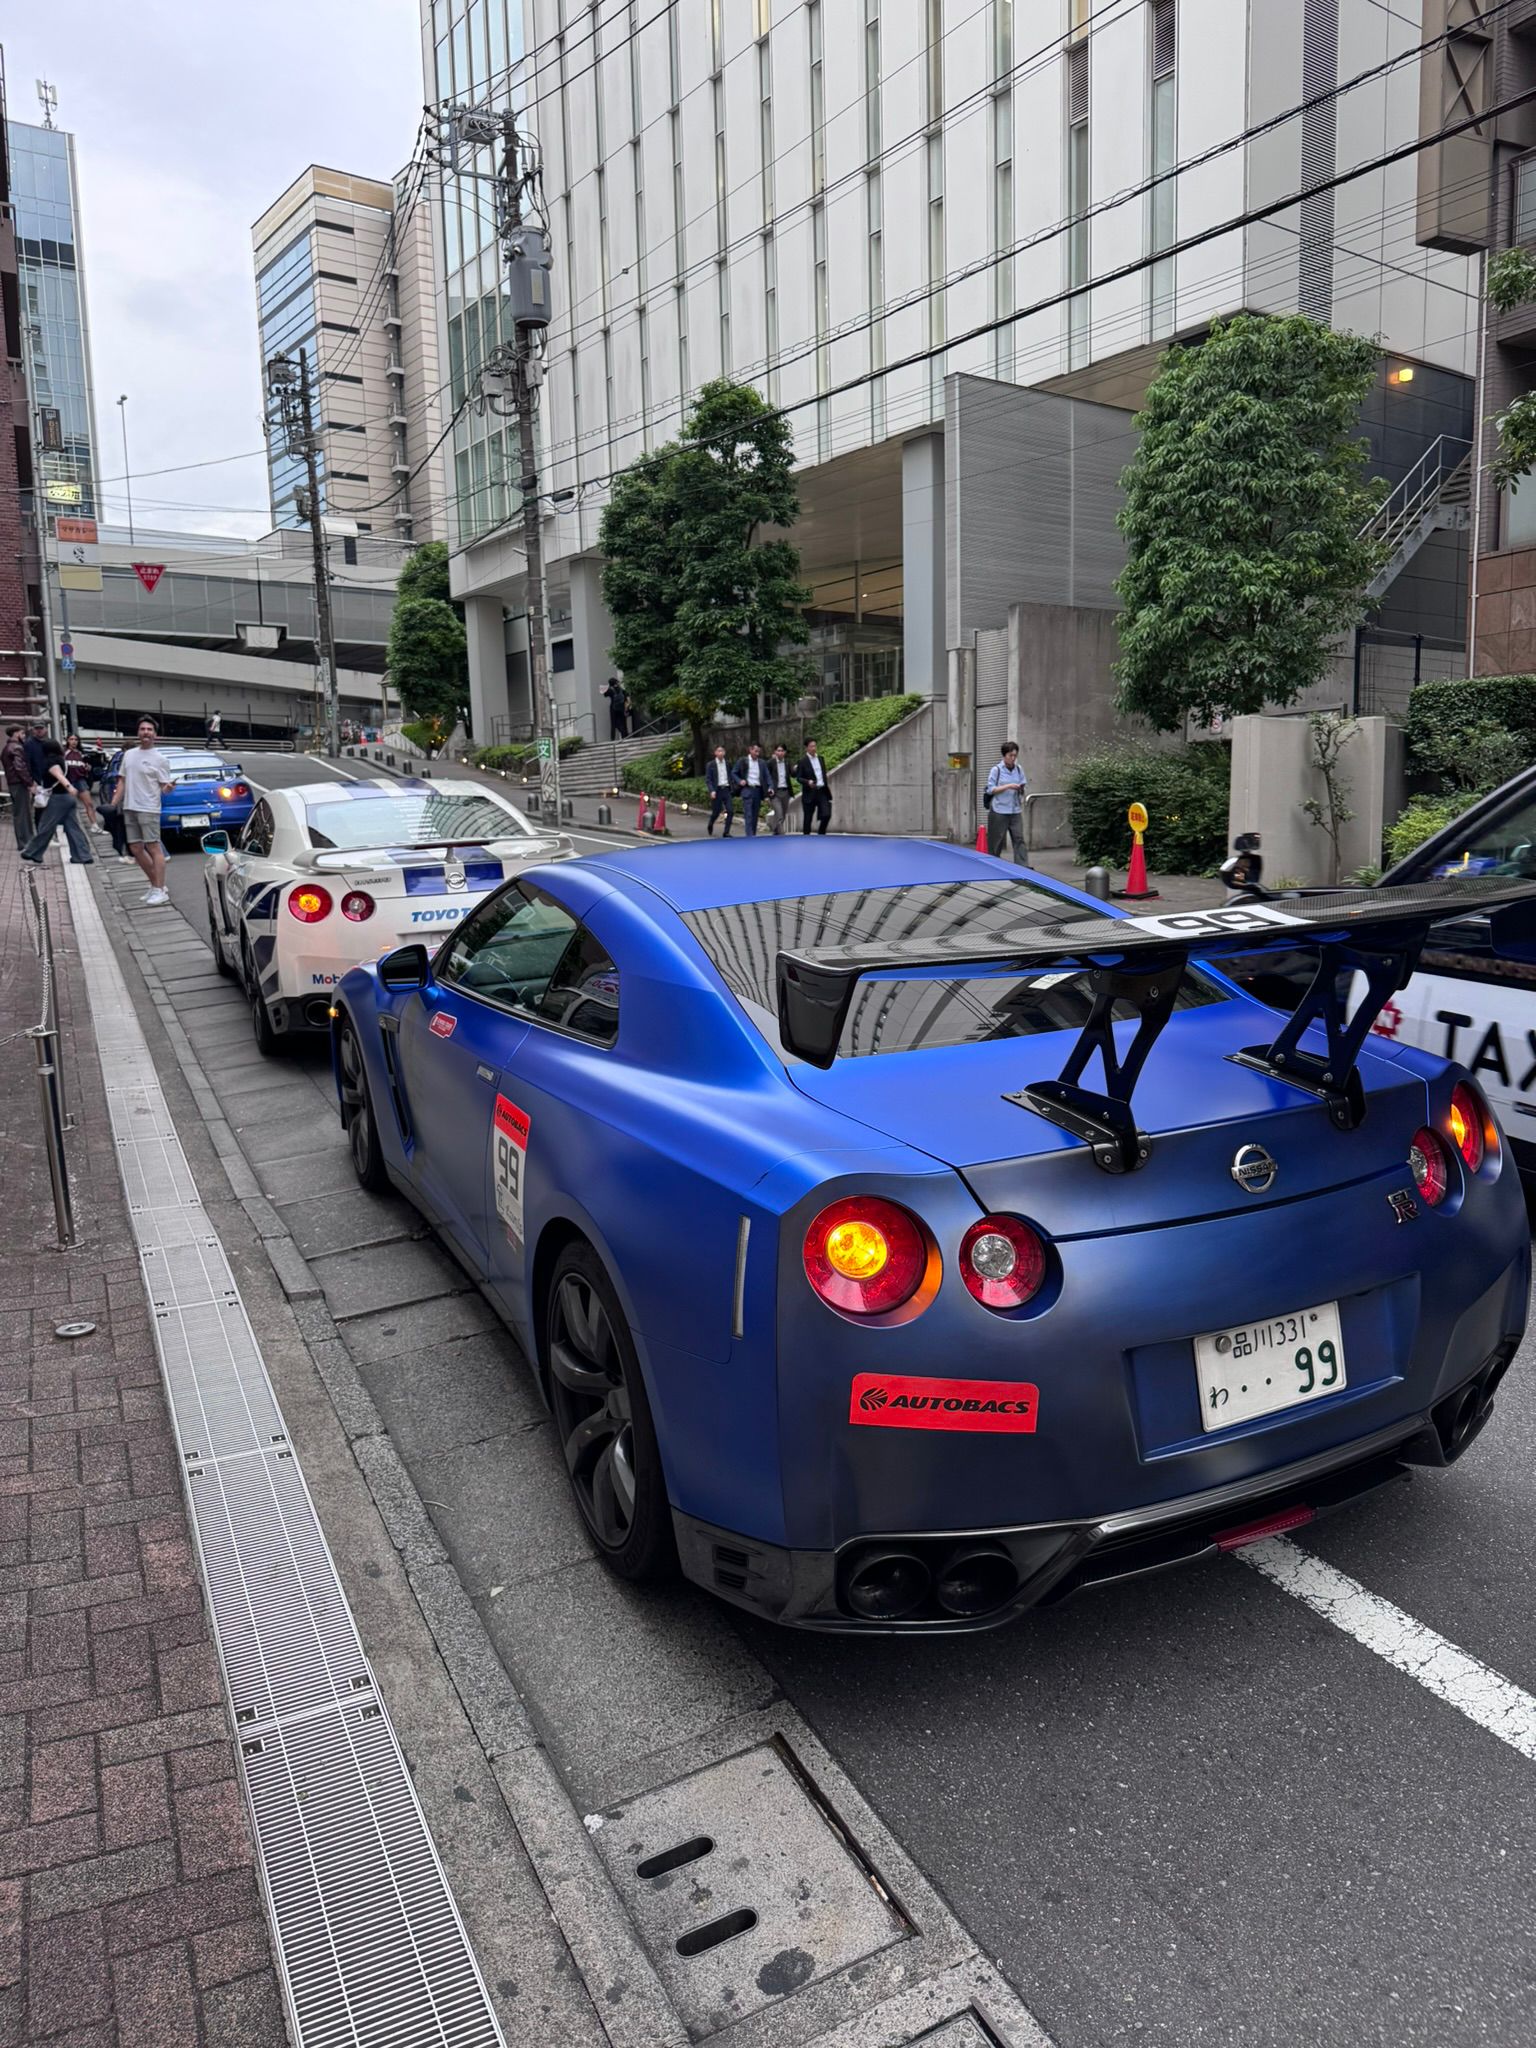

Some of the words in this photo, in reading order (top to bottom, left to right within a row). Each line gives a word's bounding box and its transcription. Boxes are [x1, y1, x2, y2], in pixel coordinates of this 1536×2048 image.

[1157, 910, 1285, 935] 99
[501, 1110, 529, 1137] AUTOBACS
[499, 1136, 520, 1201] 99
[889, 1394, 1031, 1414] AUTOBACS
